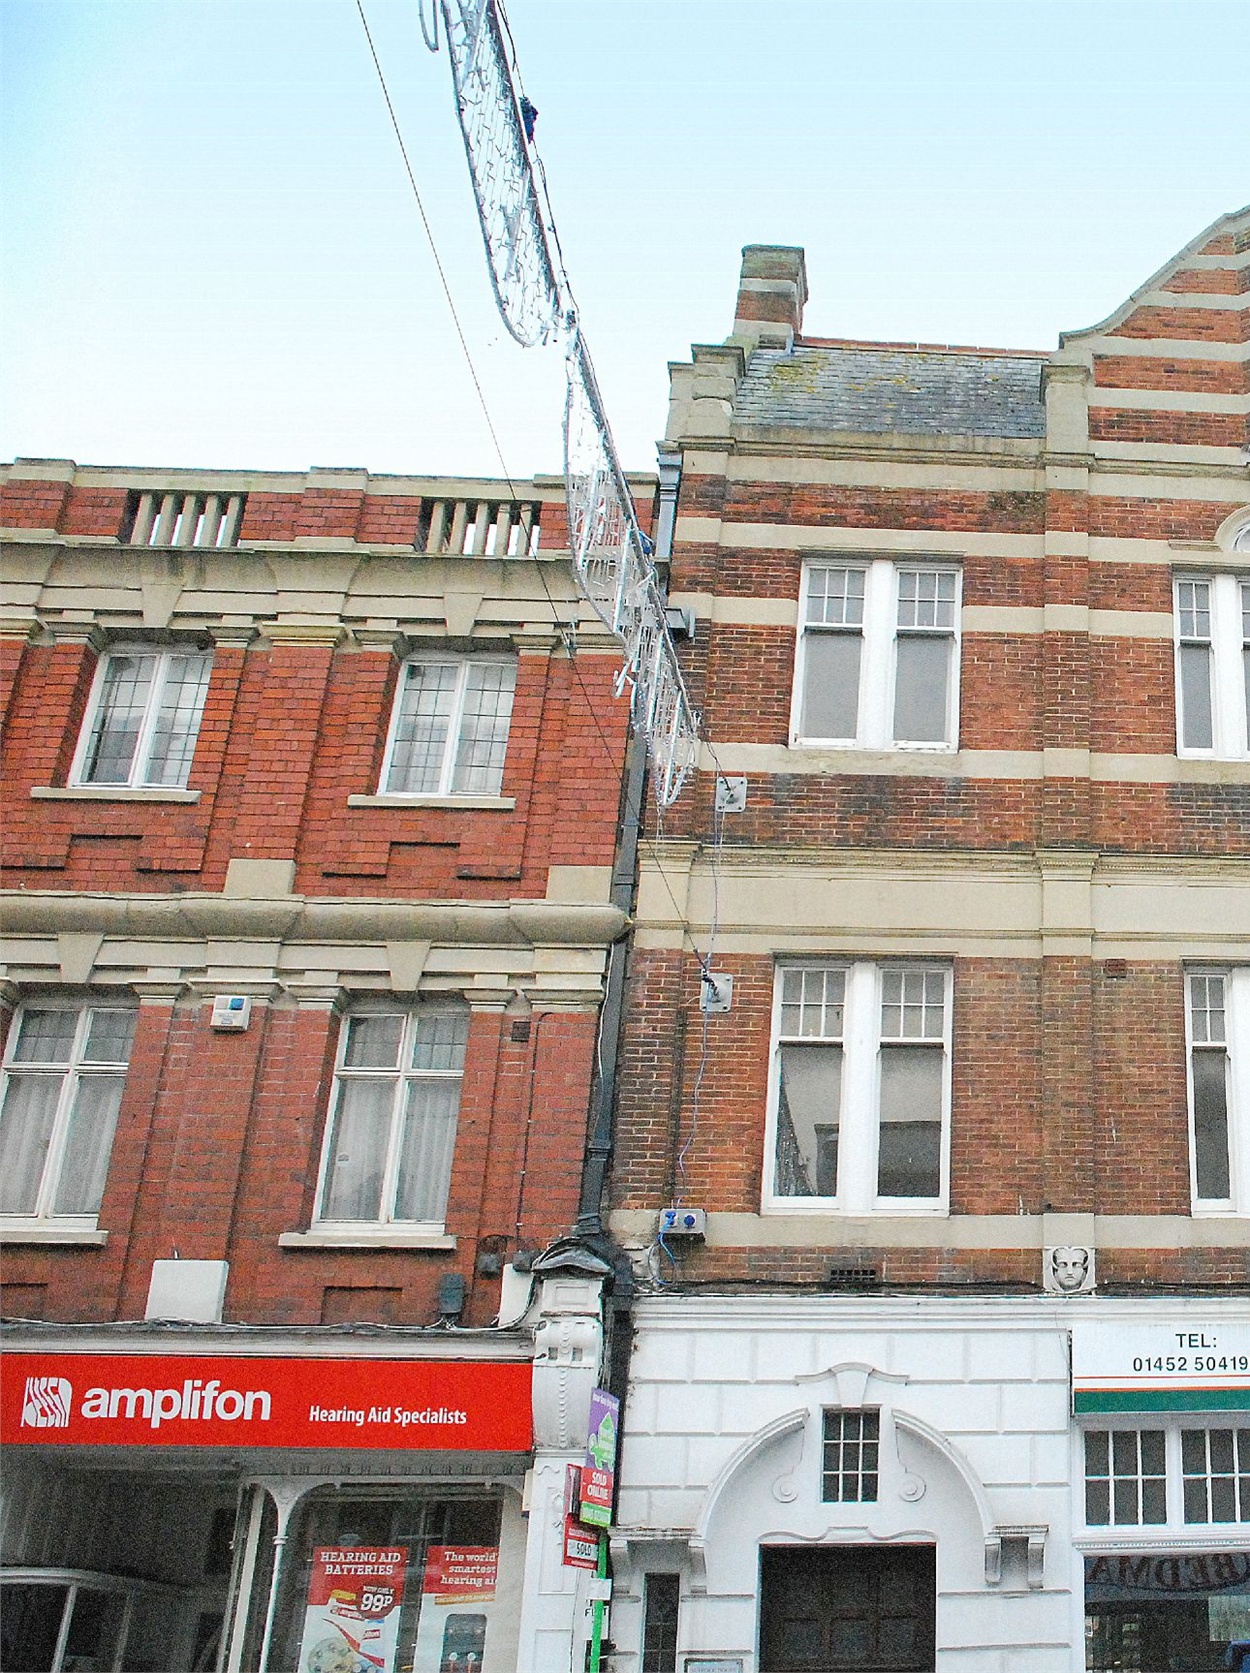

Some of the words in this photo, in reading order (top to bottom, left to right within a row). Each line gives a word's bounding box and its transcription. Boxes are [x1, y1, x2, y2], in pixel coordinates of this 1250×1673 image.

[1175, 1333, 1217, 1348] TEL:
[1132, 1356, 1188, 1372] 01452
[81, 1379, 272, 1429] amplifon
[309, 1405, 365, 1427] Hearing
[367, 1406, 391, 1423] Aid
[394, 1406, 467, 1428] Specialists
[591, 1471, 607, 1486] SOLD
[586, 1484, 609, 1500] ONLINE
[320, 1551, 377, 1562] HEARING
[379, 1552, 401, 1562] AID
[444, 1551, 465, 1561] The
[466, 1552, 498, 1562] world'
[576, 1542, 592, 1557] SOLD
[325, 1564, 394, 1575] BATTERIES
[449, 1564, 496, 1573] smartest
[440, 1575, 483, 1587] hearing
[484, 1576, 497, 1584] ai
